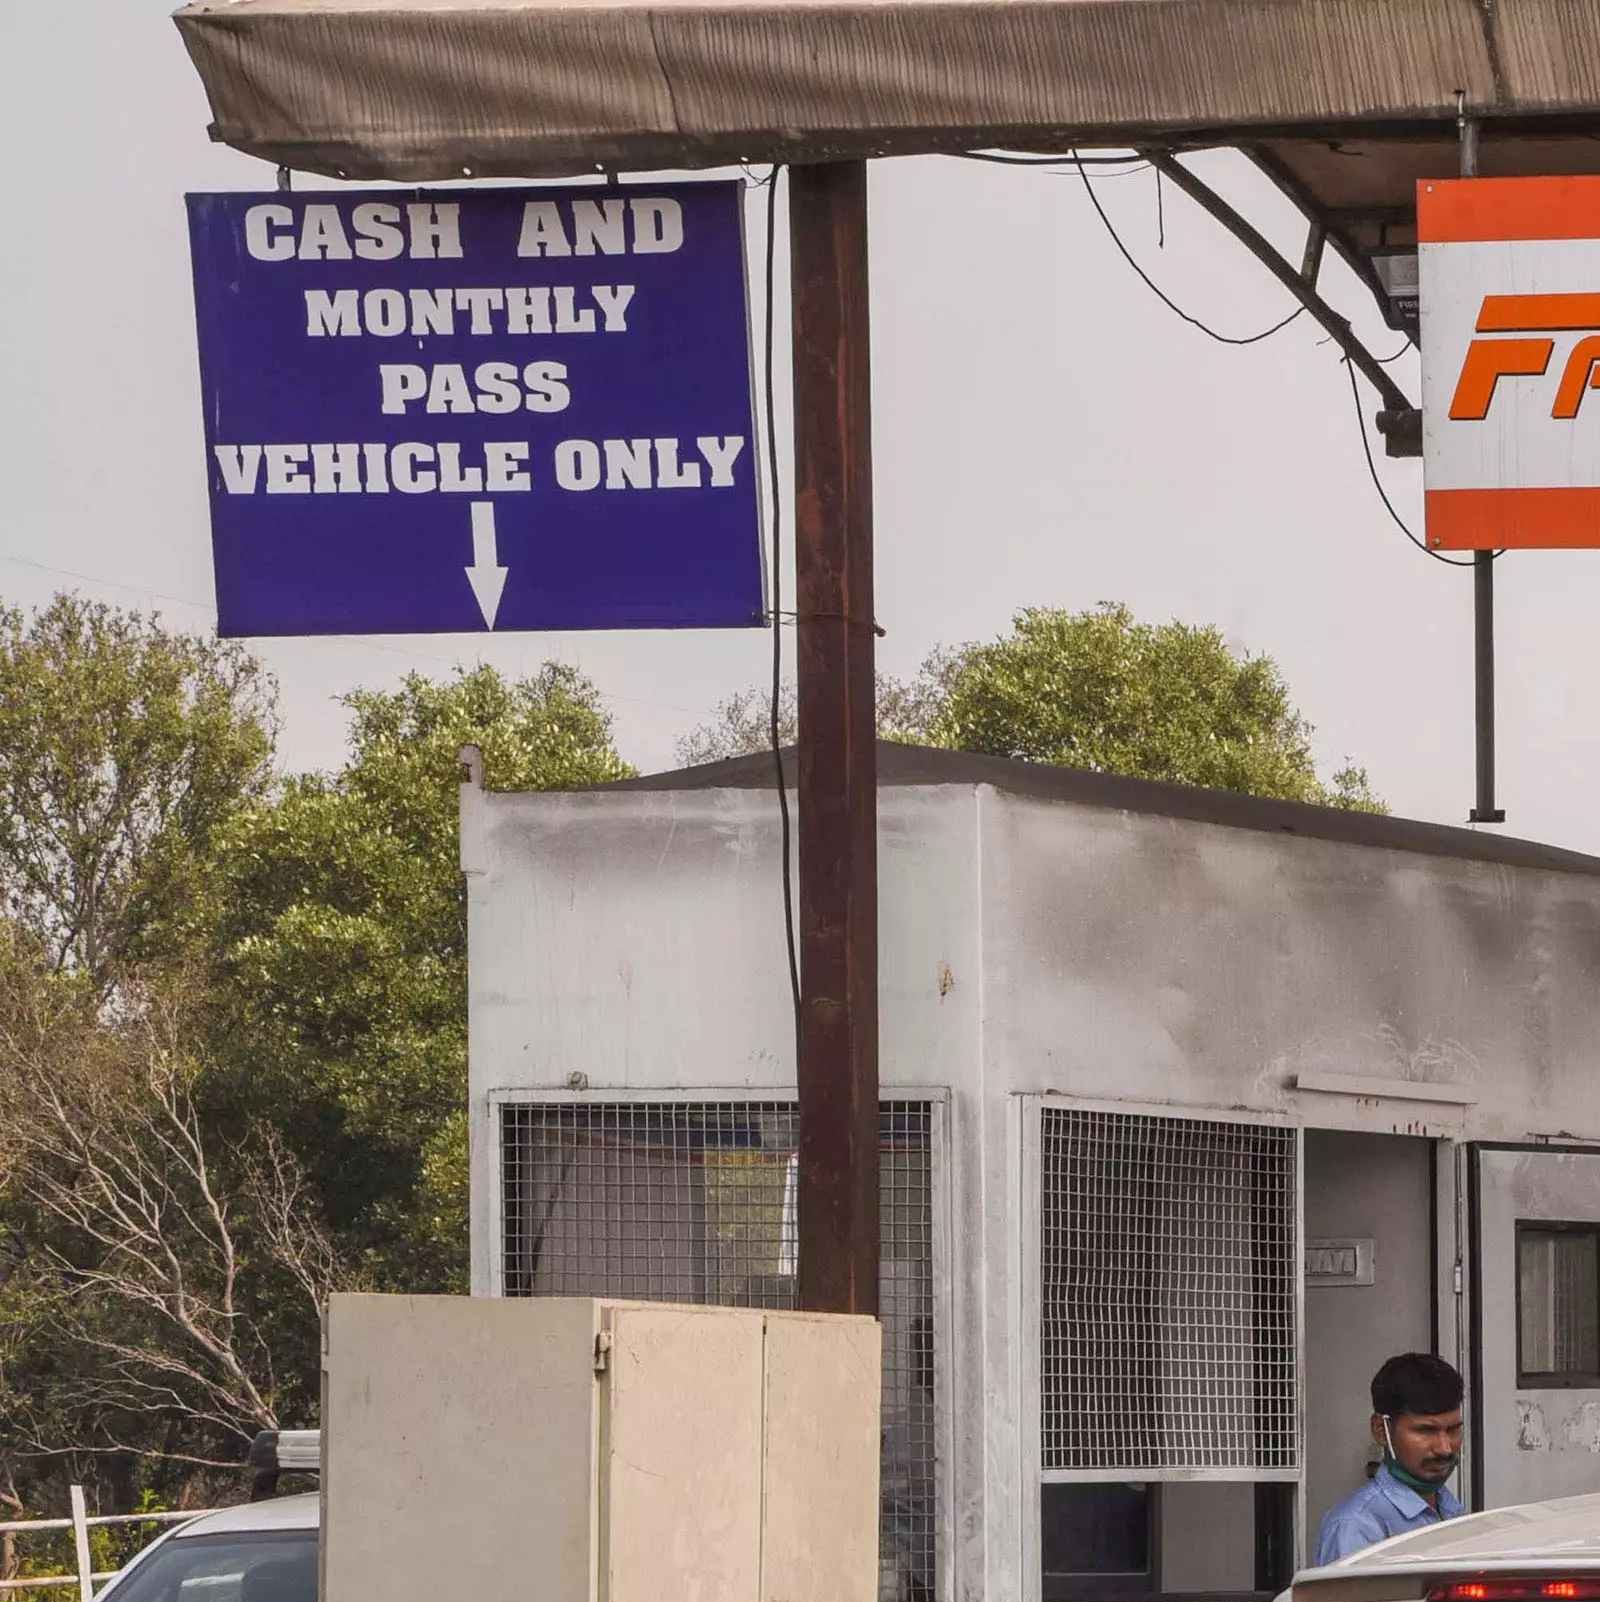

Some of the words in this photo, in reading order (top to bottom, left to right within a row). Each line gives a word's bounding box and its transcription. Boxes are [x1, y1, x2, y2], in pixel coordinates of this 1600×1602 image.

[245, 203, 464, 261] CASH
[517, 198, 685, 258] AND
[304, 284, 636, 337] MONTHLY
[379, 361, 571, 415] PASS
[214, 441, 532, 495] VEHICLE
[554, 436, 745, 491] ONLY
